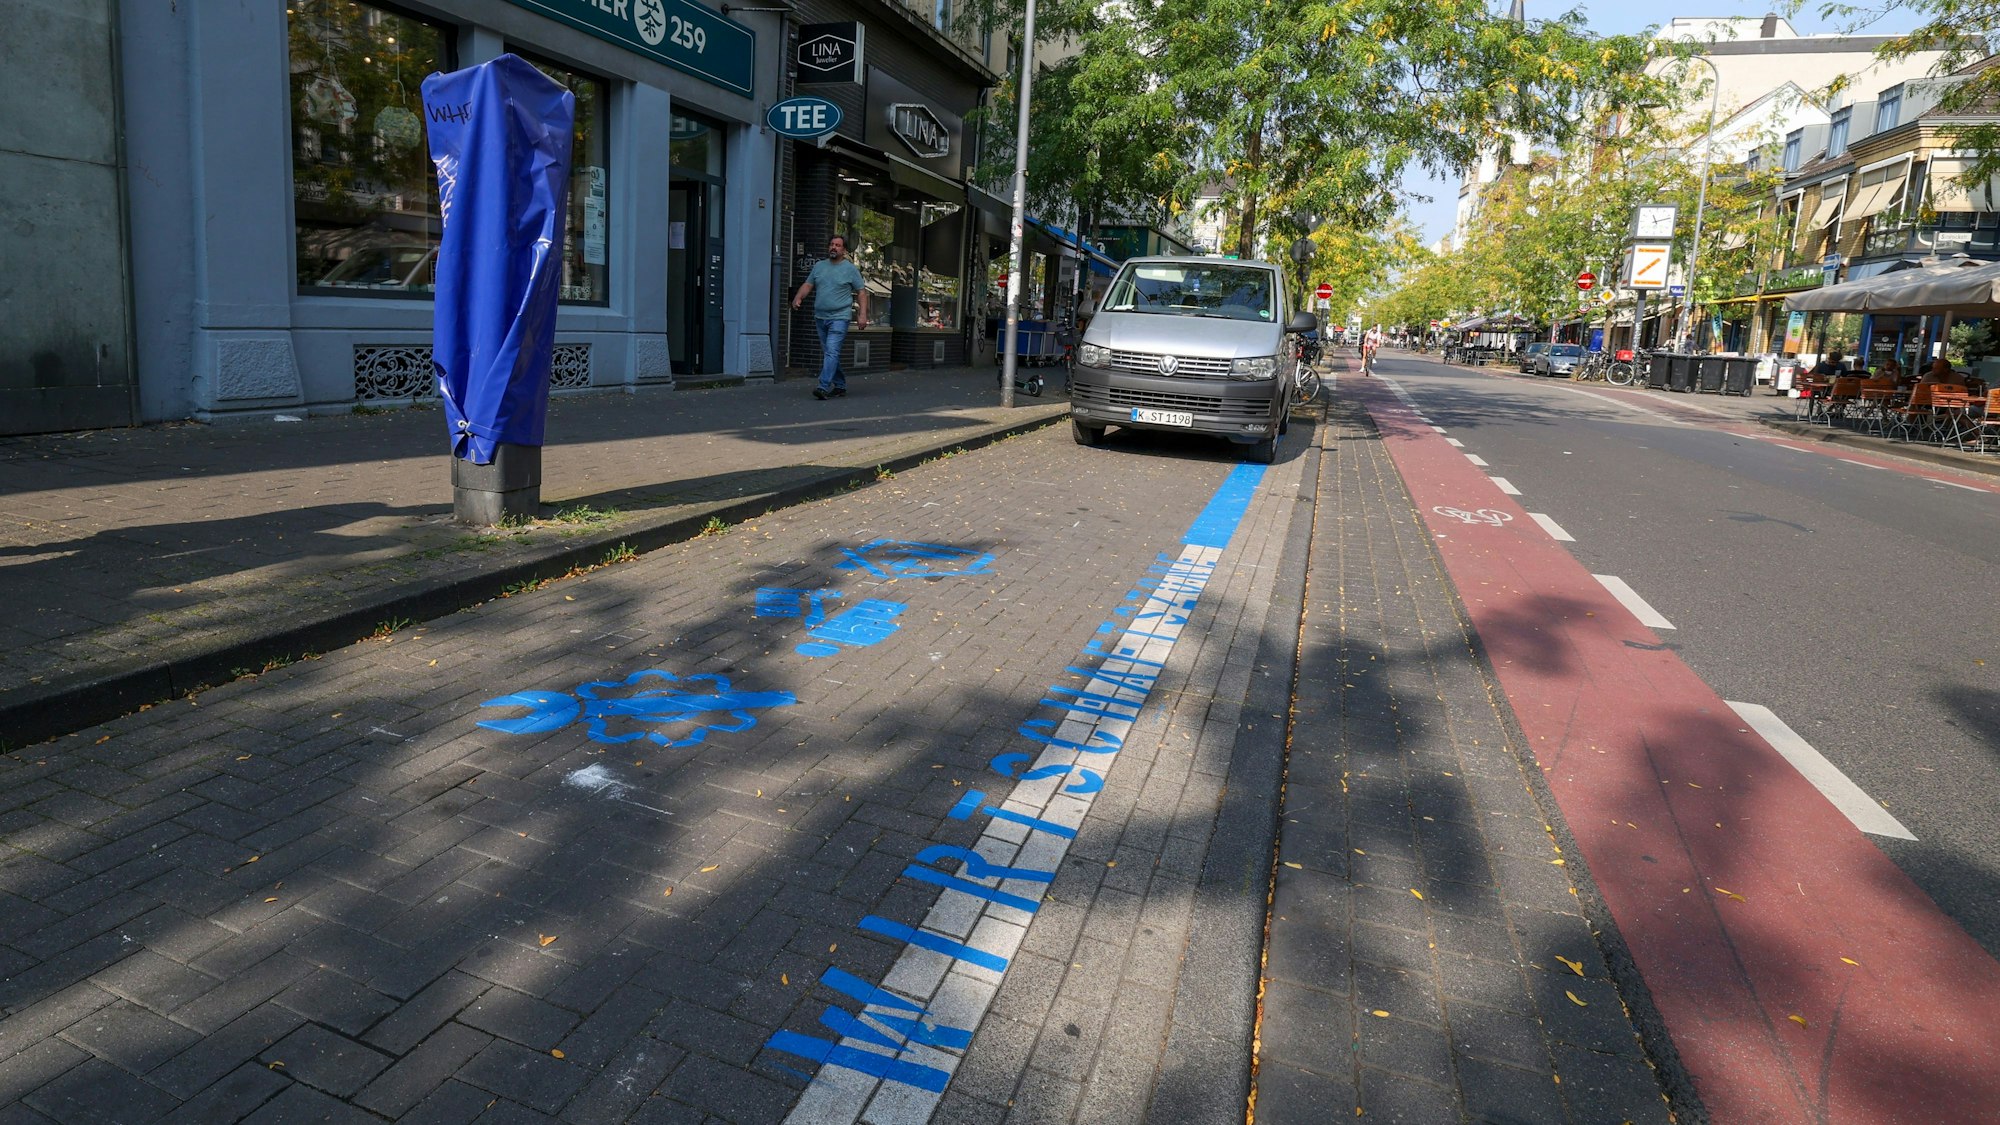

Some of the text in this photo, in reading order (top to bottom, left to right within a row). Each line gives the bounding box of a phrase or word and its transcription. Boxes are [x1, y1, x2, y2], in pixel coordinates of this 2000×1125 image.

[670, 15, 707, 54] 259
[811, 42, 841, 57] LINA
[816, 56, 838, 64] Juwelier
[781, 105, 827, 130] TEE
[905, 110, 939, 149] LINA
[1138, 410, 1191, 424] K ST 1198
